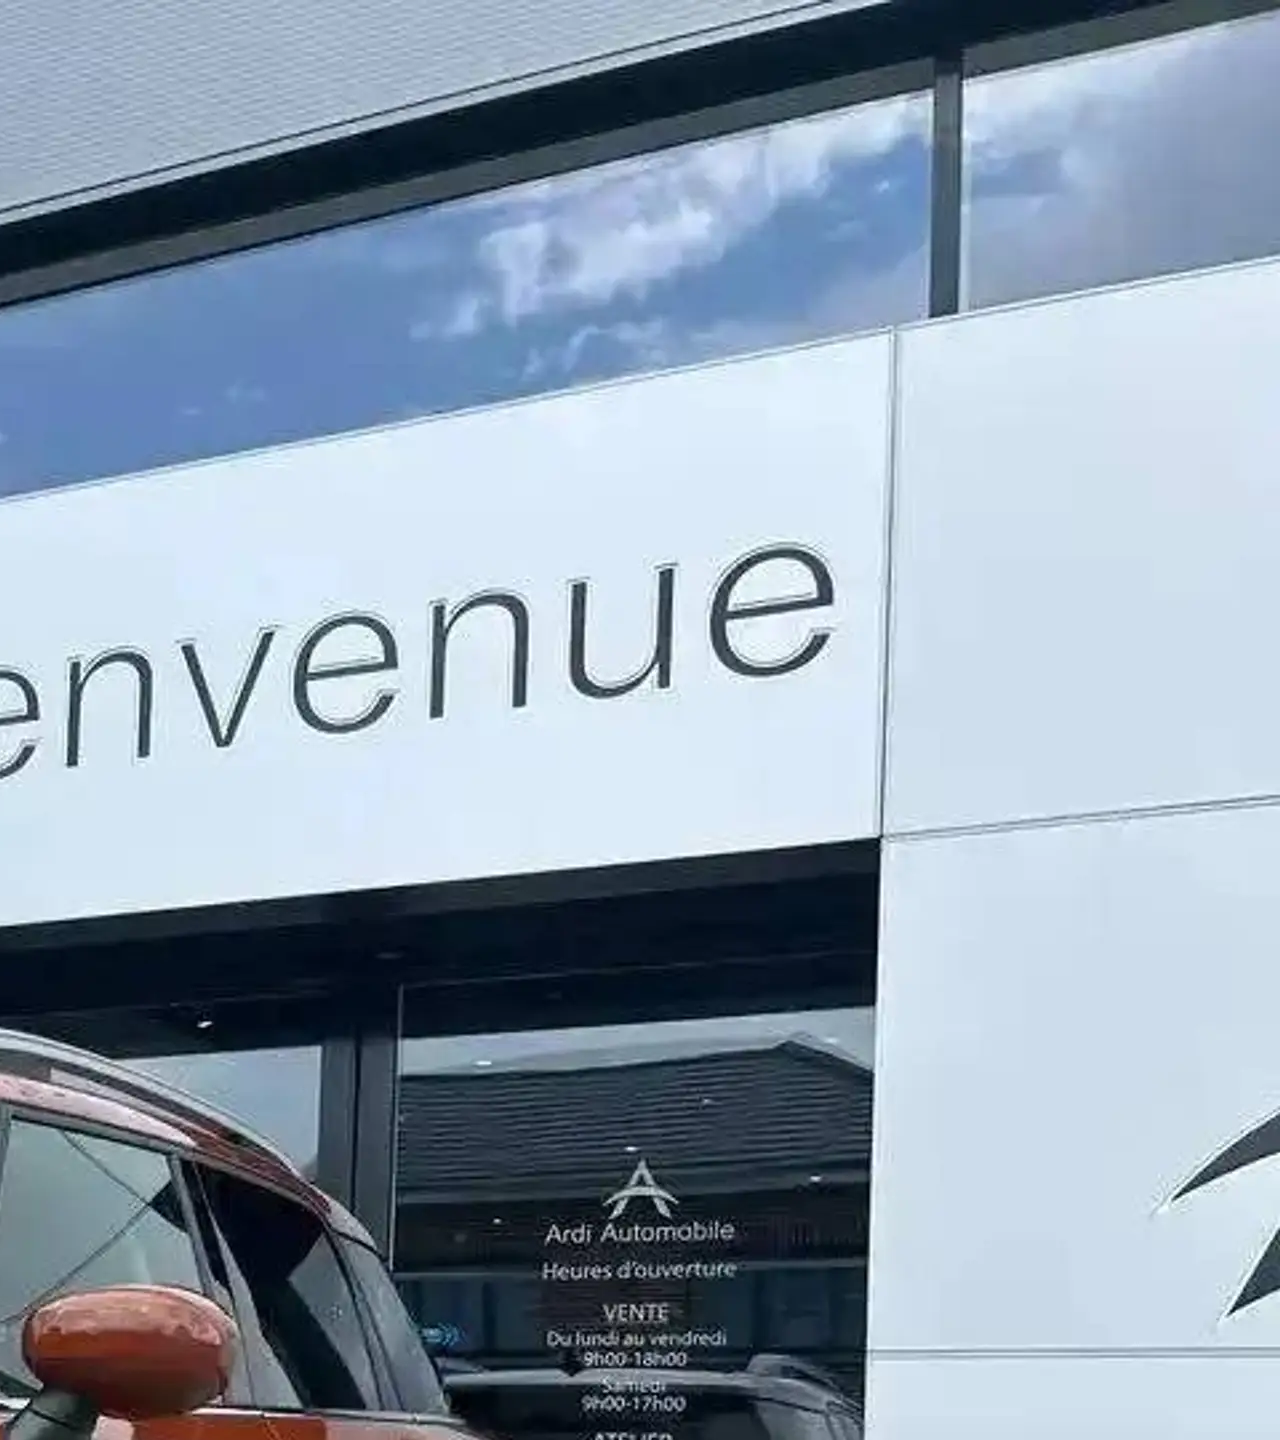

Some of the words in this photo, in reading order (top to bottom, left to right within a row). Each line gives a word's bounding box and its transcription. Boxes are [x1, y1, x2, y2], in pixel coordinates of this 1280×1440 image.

[545, 1224, 593, 1243] Ardi
[601, 1221, 736, 1242] Automobile
[542, 1262, 612, 1280] Heures
[617, 1261, 738, 1279] d'ouverture
[602, 1304, 670, 1322] VENTE
[547, 1331, 570, 1346] Du
[573, 1331, 619, 1346] lundi
[623, 1334, 644, 1346] au
[648, 1331, 727, 1346] vendredi
[583, 1351, 688, 1367] 9h00-18h00
[581, 1396, 686, 1412] 9h00-17h00
